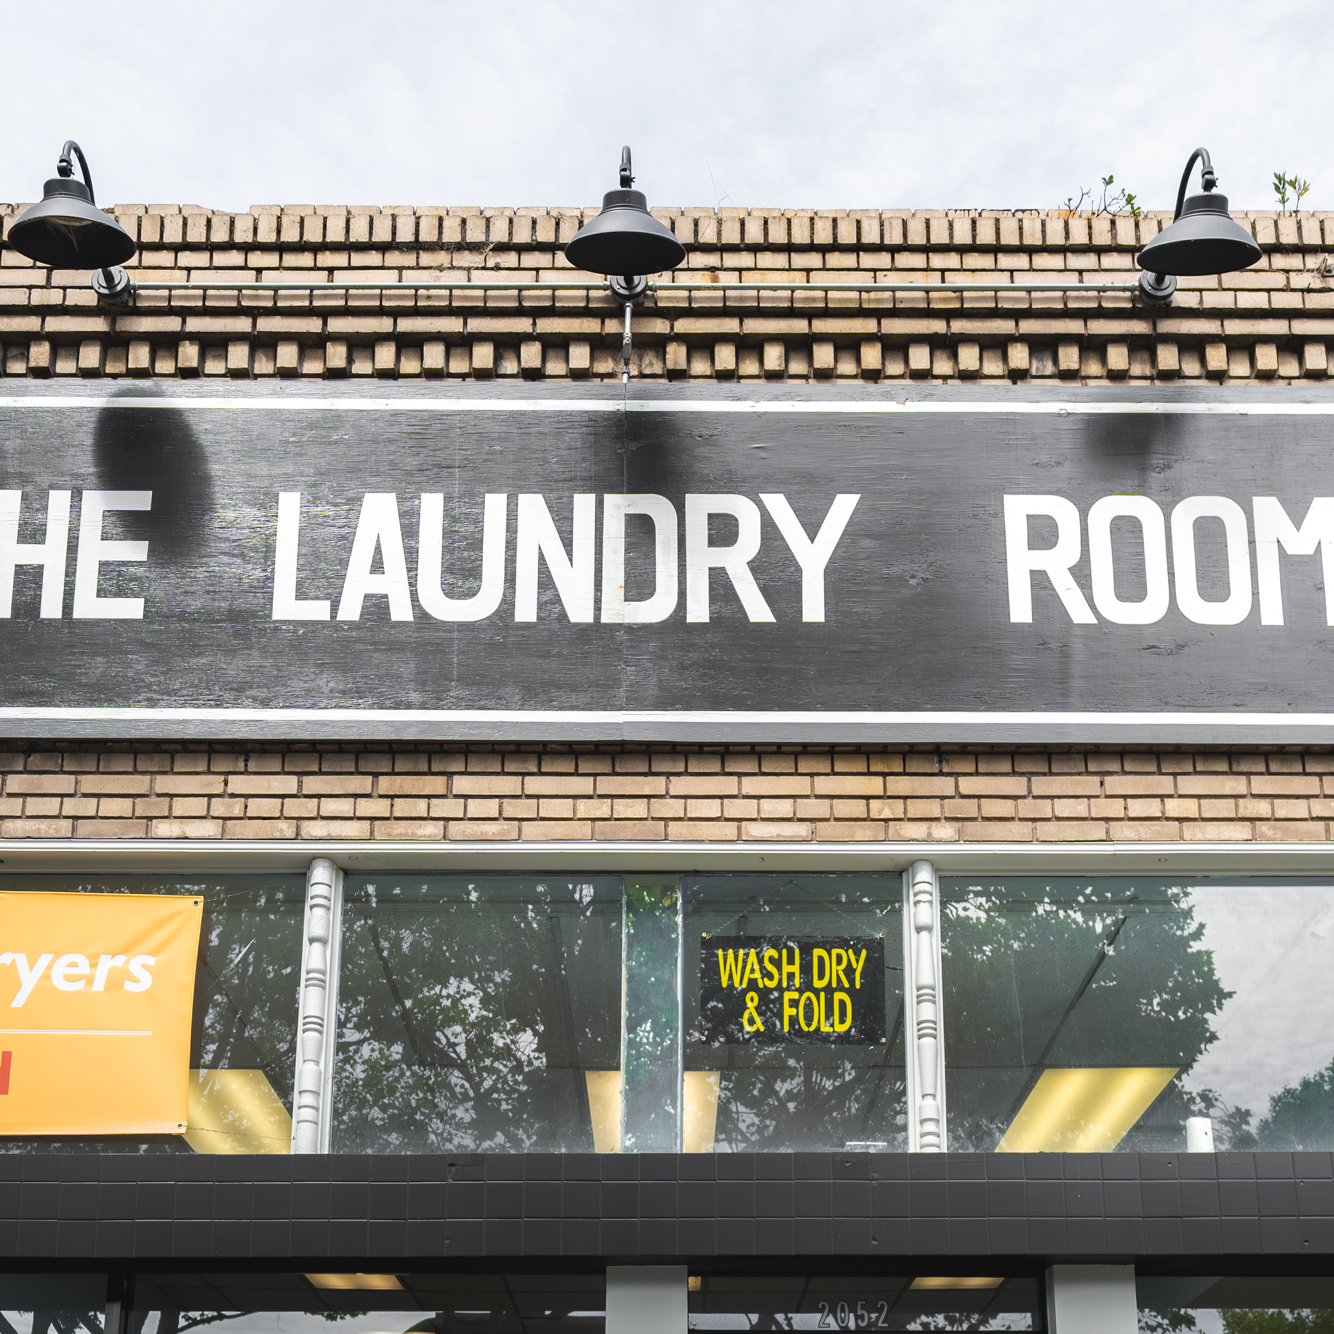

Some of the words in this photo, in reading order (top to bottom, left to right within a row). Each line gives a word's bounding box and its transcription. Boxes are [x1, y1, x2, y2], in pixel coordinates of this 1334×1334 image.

[271, 490, 861, 624] LAUNDRY
[717, 947, 801, 989] WASH
[812, 947, 868, 989] DRY
[742, 990, 765, 1033] &
[782, 990, 853, 1033] FOLD
[818, 1301, 889, 1328] 2052
